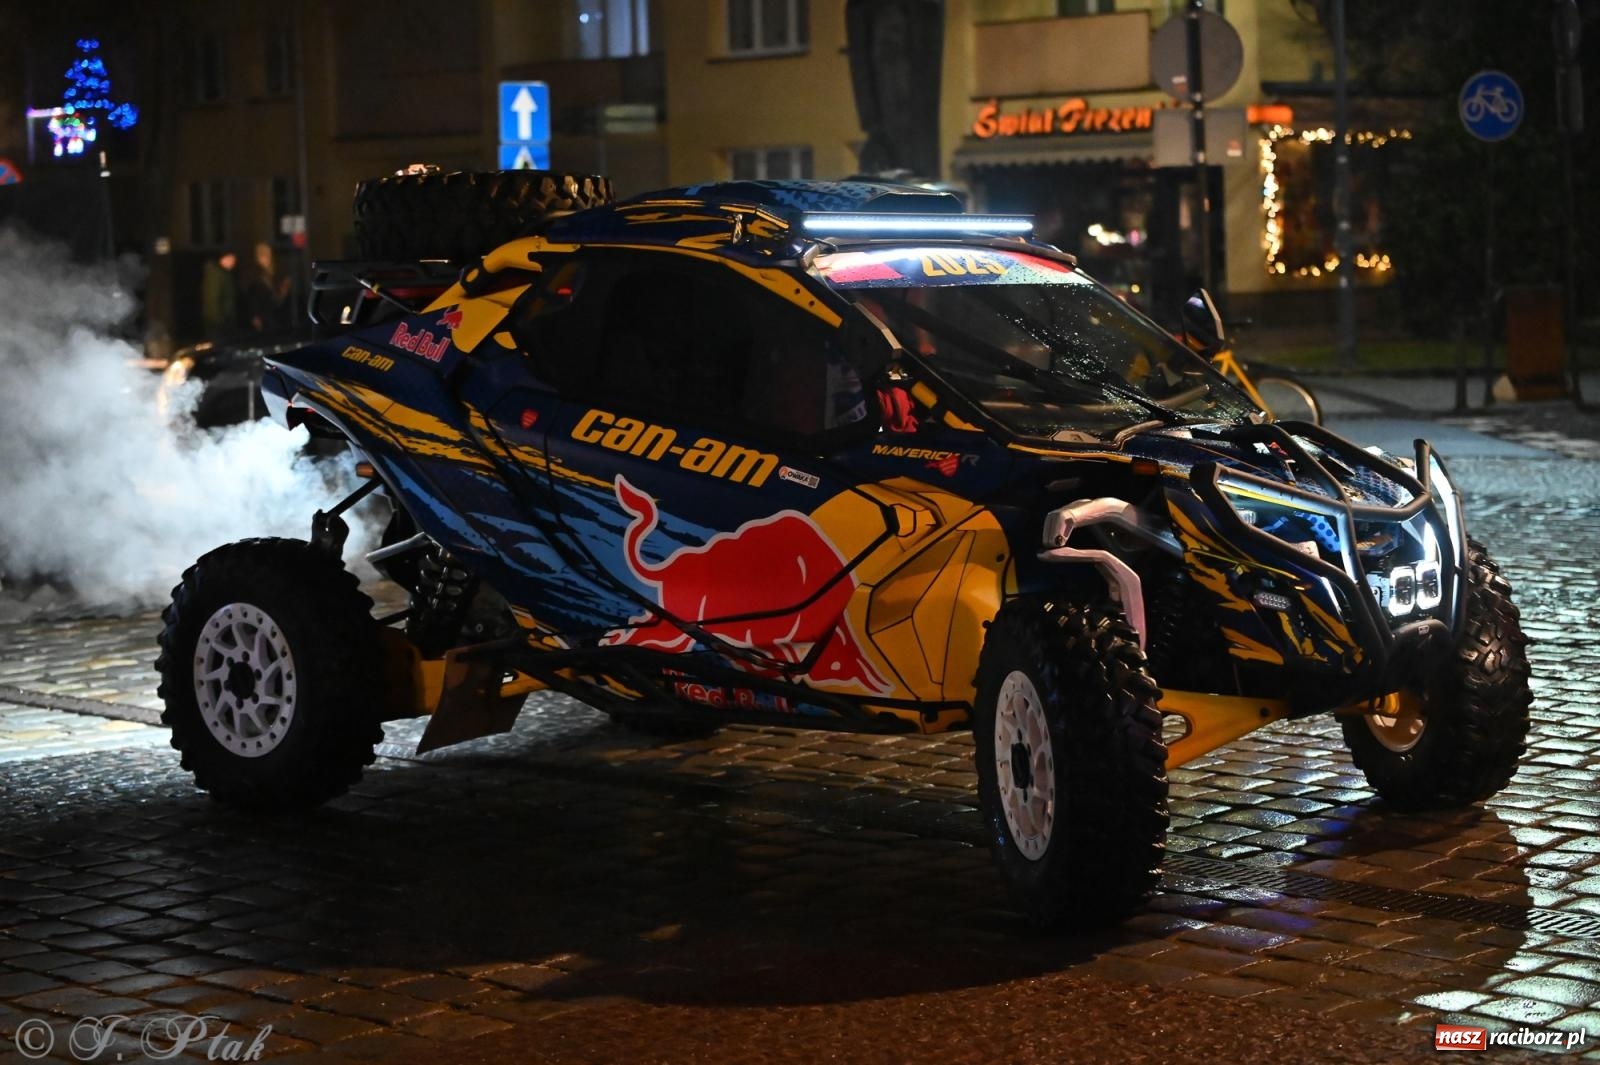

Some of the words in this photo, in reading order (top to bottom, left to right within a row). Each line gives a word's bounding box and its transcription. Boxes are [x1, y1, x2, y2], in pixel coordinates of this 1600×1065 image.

[921, 252, 1009, 277] 2025
[341, 345, 395, 372] can-am
[388, 321, 426, 352] Red
[414, 331, 451, 363] Bull
[570, 408, 779, 488] can-am
